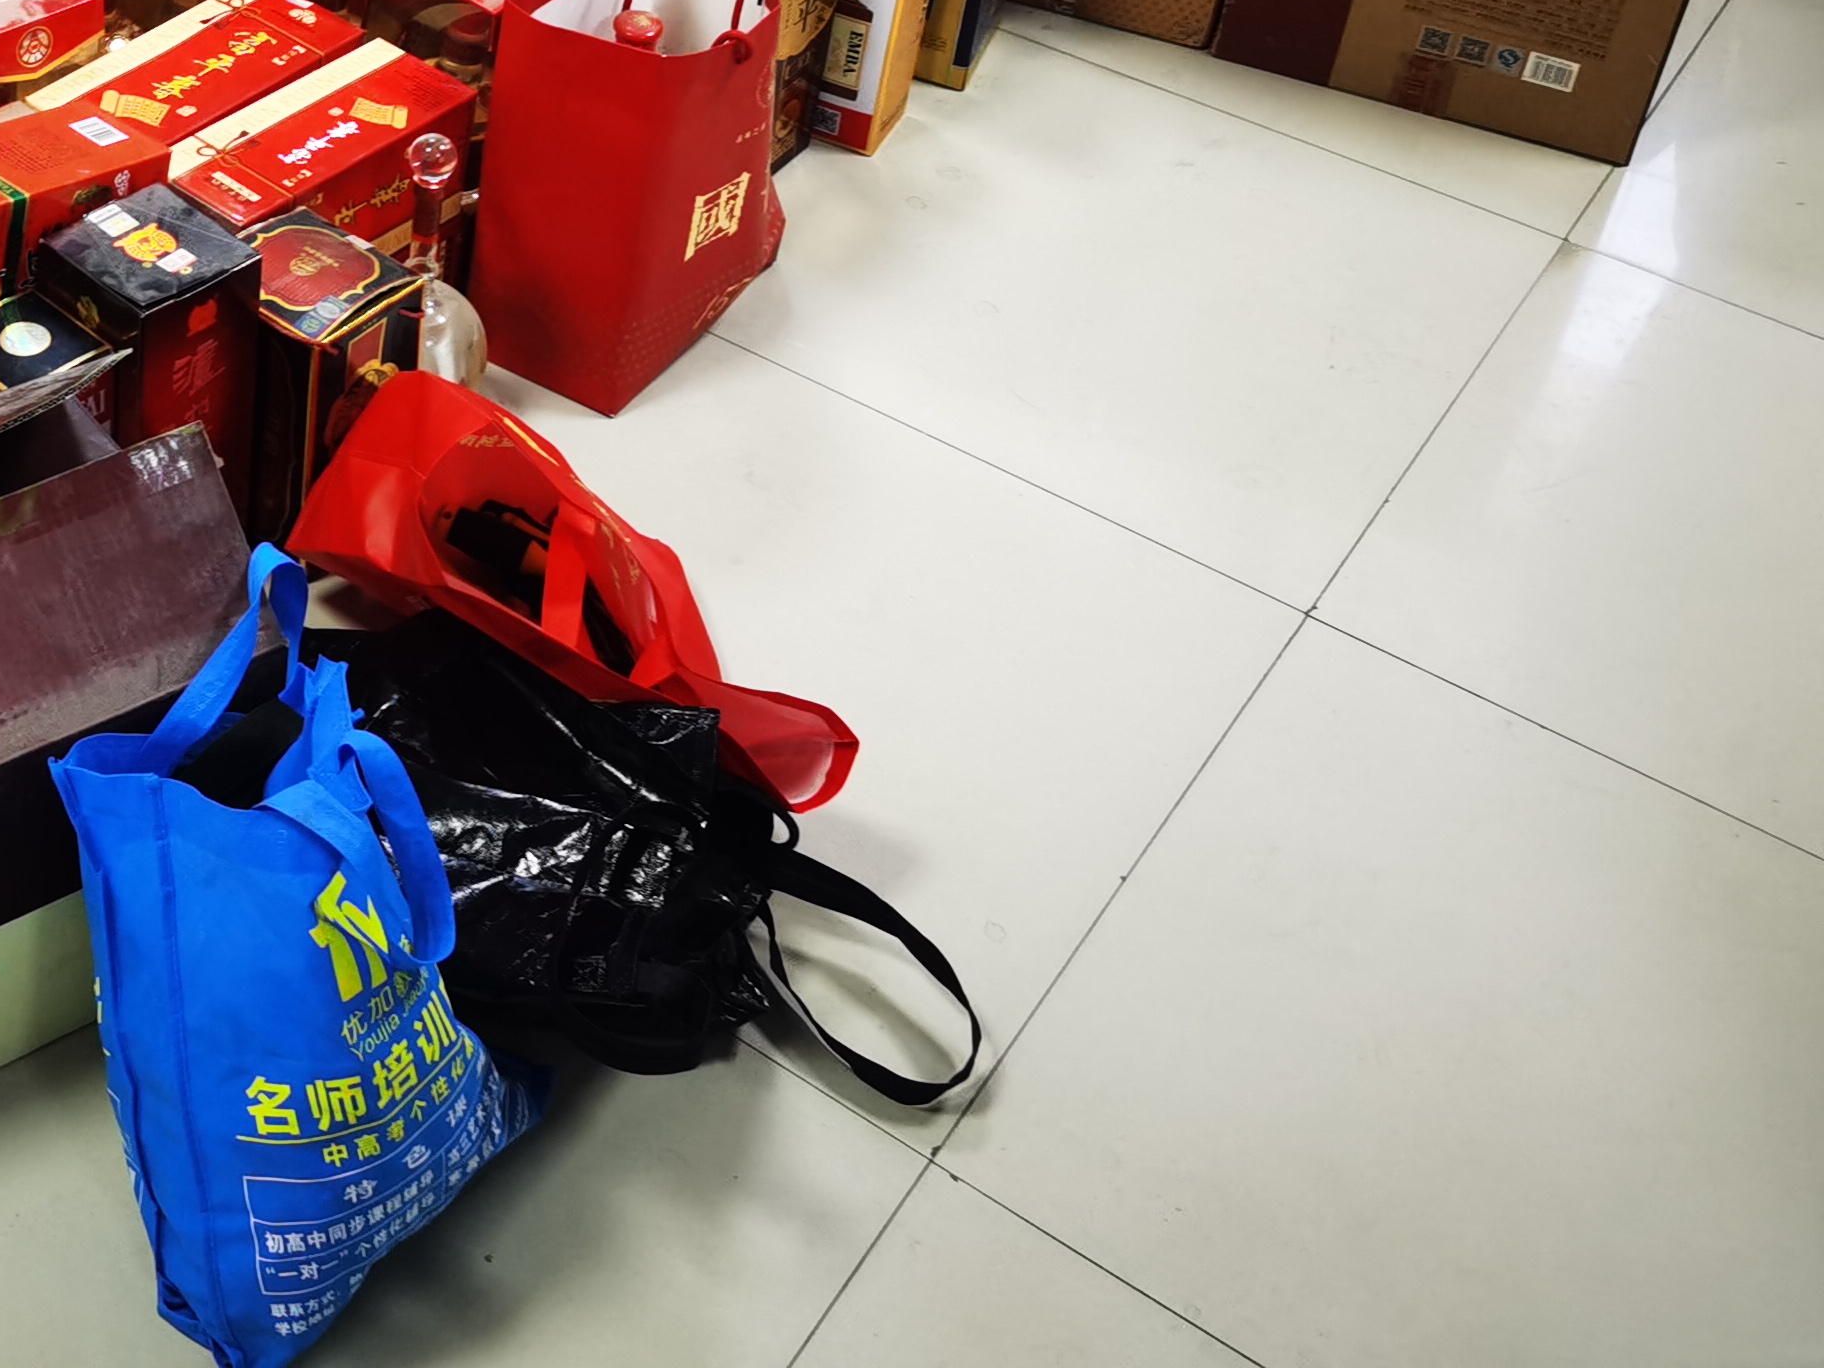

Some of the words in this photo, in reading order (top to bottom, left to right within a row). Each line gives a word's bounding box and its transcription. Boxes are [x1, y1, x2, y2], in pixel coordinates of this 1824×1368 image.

[843, 28, 865, 78] EMBA
[349, 1012, 401, 1062] Youjia
[245, 991, 458, 1137] 名师培训
